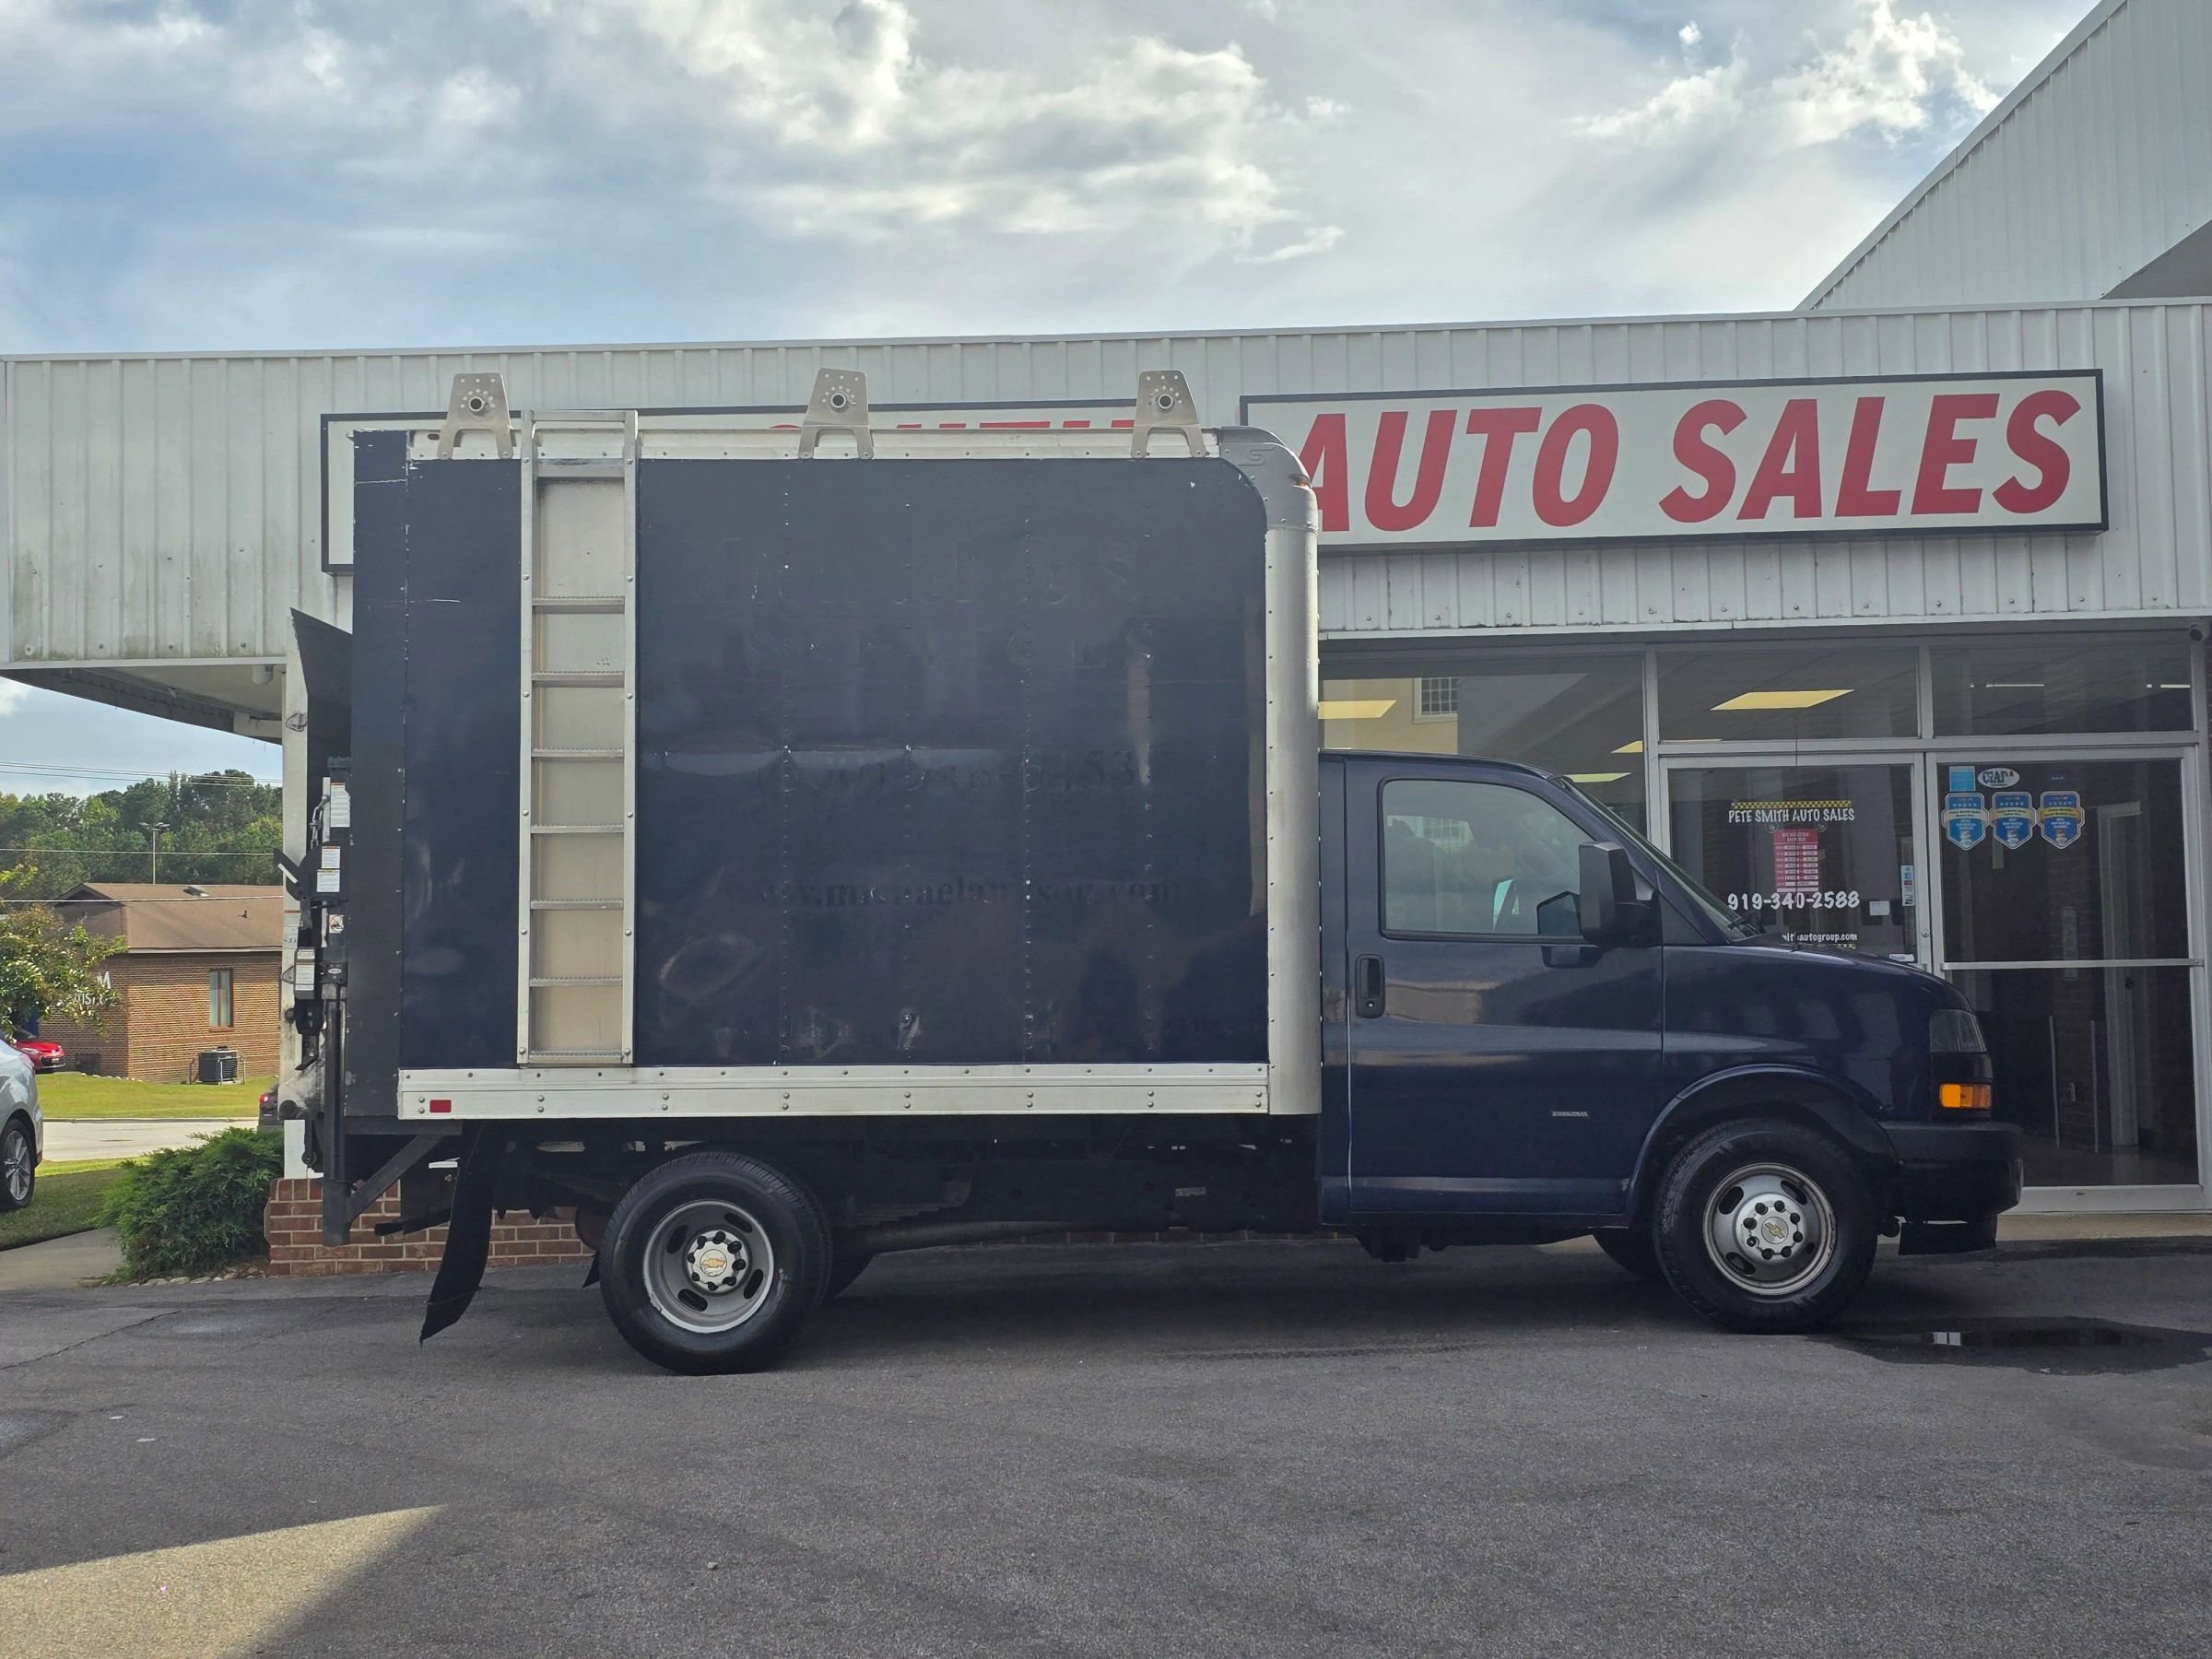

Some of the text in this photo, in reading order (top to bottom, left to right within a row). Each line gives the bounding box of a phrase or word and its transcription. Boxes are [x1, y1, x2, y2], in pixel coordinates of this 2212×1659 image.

[1294, 390, 2082, 532] AUTO SALES
[1728, 807, 1855, 823] PETE SMITH AUTO SALES
[1727, 889, 1861, 911] 919-340-2588
